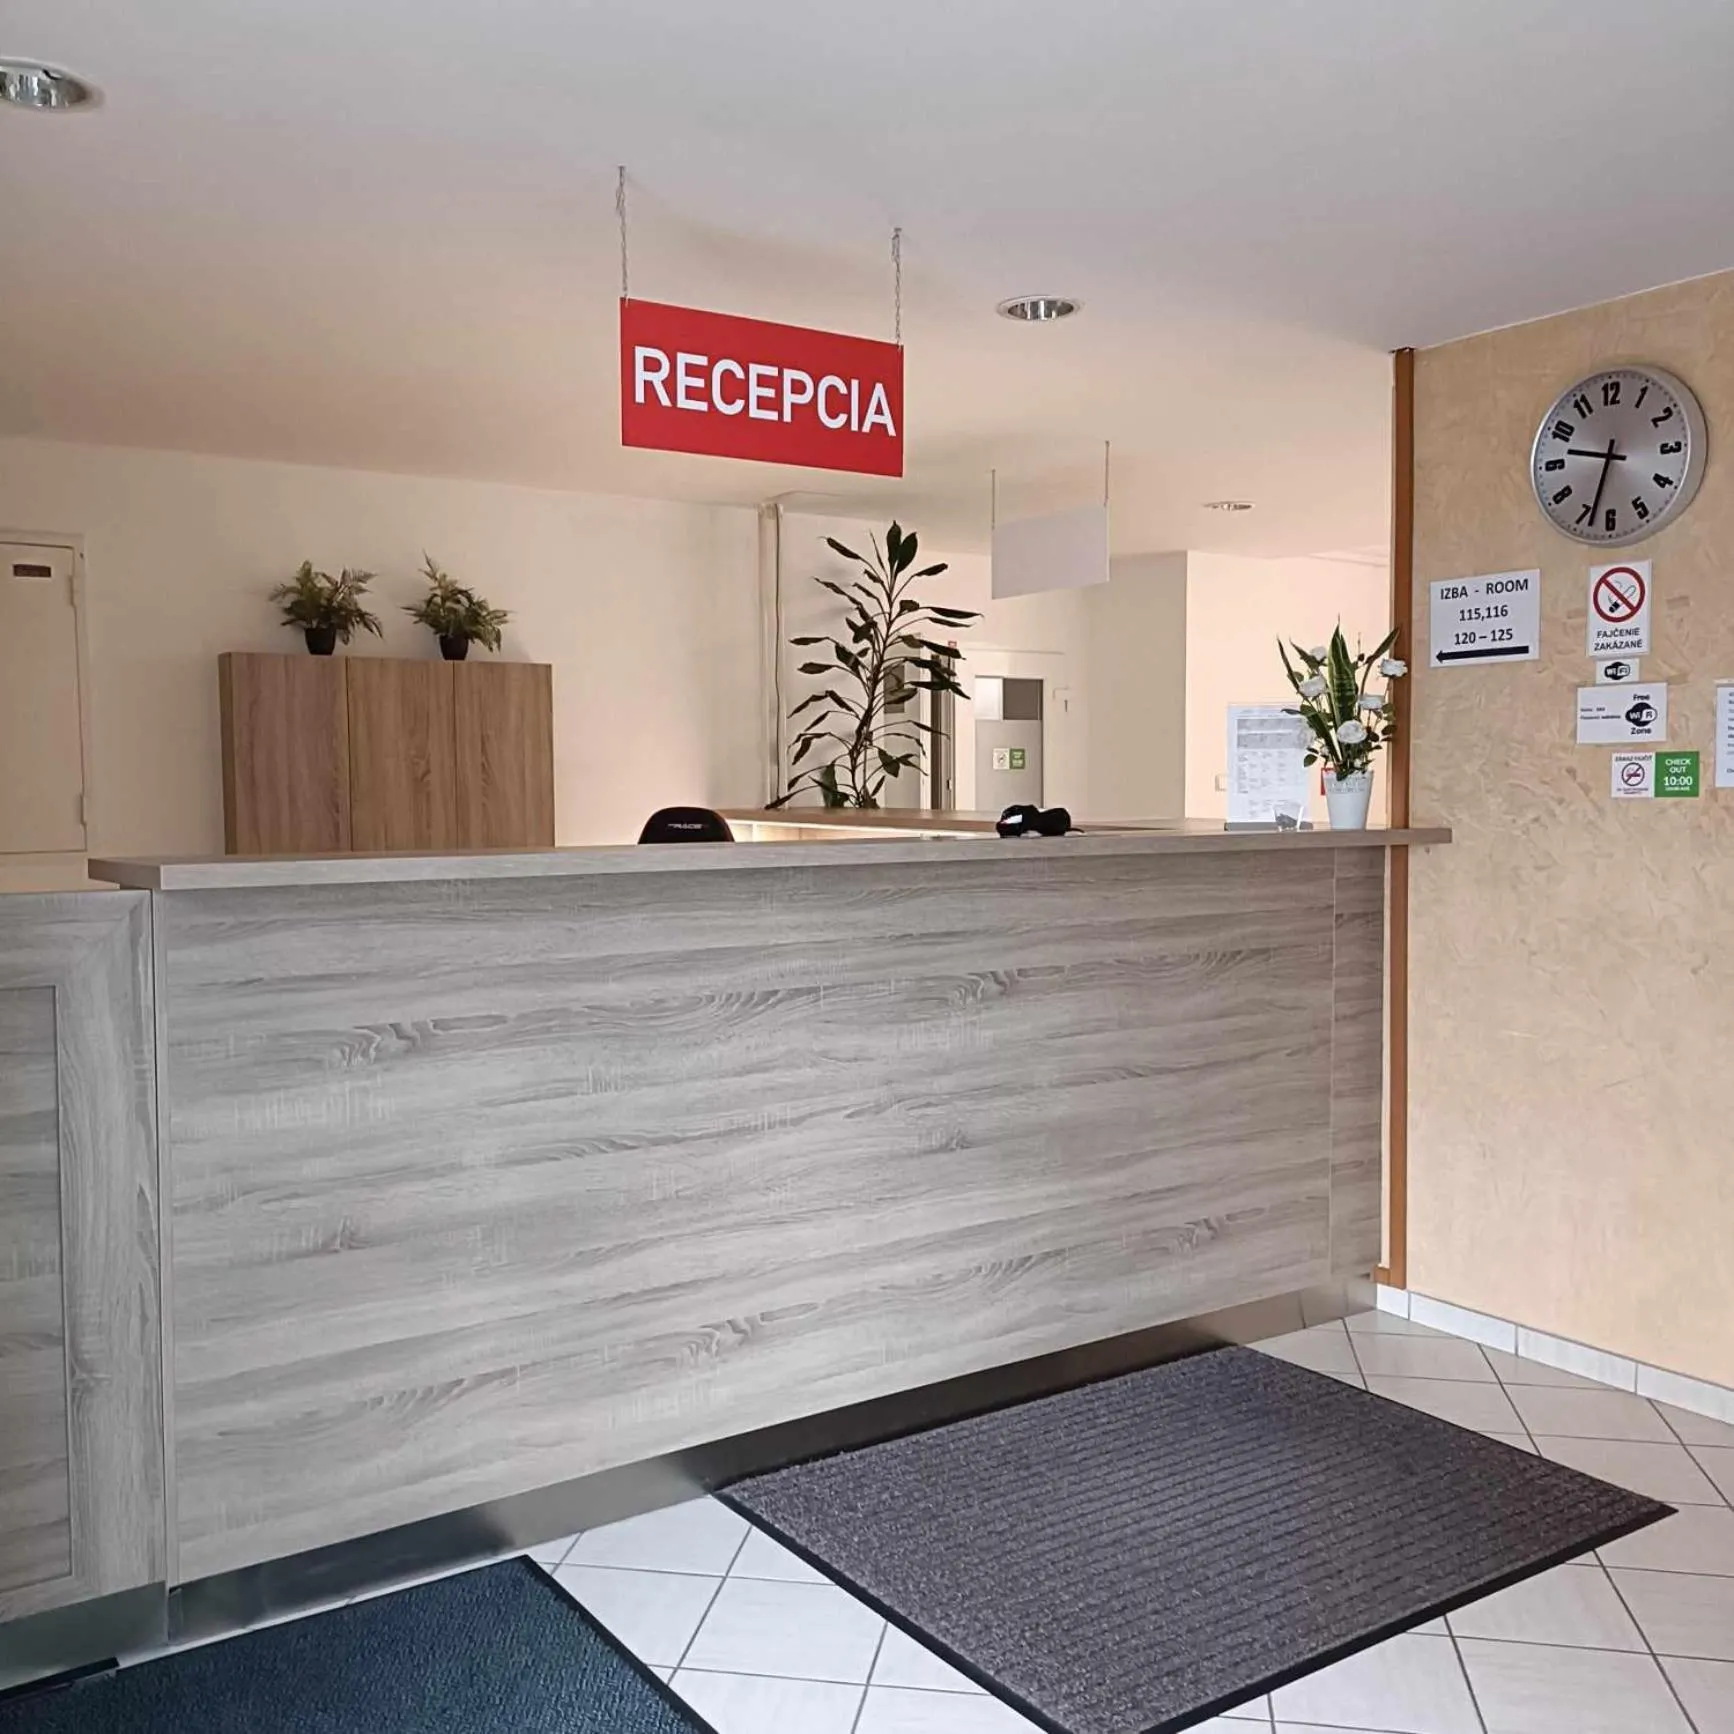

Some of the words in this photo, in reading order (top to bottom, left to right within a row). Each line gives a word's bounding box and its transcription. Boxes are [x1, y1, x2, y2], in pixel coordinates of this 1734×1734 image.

[634, 345, 897, 437] RECEPCIA
[1601, 381, 1621, 407] 12
[1634, 385, 1648, 409] 1
[1572, 394, 1594, 419] 11
[1651, 406, 1673, 428] 2
[1551, 420, 1575, 443] 10
[1660, 441, 1682, 455] 3
[1545, 458, 1566, 472] 9
[1652, 473, 1674, 489] 4
[1552, 484, 1573, 505] 8
[1575, 503, 1591, 525] 7
[1631, 496, 1650, 520] 5
[1605, 508, 1617, 531] 6
[1440, 585, 1469, 600] IZBA
[1486, 578, 1529, 595] ROOM
[1459, 604, 1509, 622] 115,116
[1454, 631, 1477, 646] 120
[1491, 628, 1514, 642] 125
[1596, 626, 1641, 639] FAJČENIE
[1593, 638, 1643, 652] ZAKÁZANÉ
[1630, 727, 1652, 735] Zone
[1665, 758, 1691, 766] CHECK
[1669, 766, 1687, 774] OUT
[1663, 776, 1693, 786] 10:00
